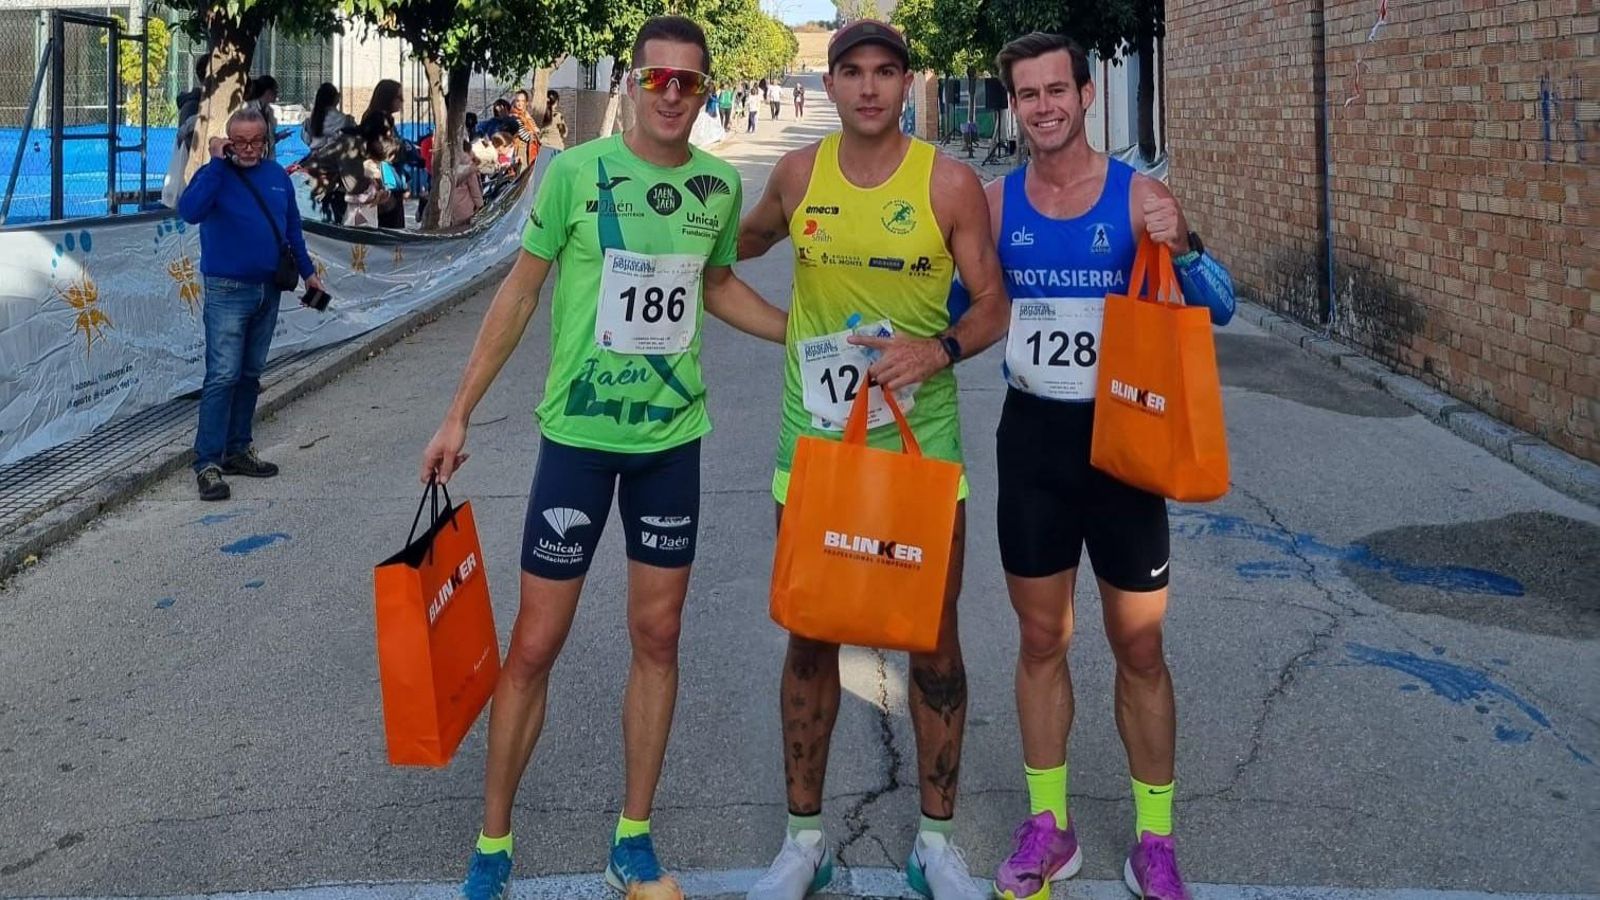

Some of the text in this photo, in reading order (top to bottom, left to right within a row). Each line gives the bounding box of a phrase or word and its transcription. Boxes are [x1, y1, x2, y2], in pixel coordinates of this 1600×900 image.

[1007, 269, 1124, 288] TROTASIERRA
[619, 286, 687, 323] 186
[1026, 330, 1097, 367] 128
[1110, 379, 1166, 412] BLINKER
[539, 537, 583, 555] Unicaja
[823, 530, 923, 562] BLINKER
[428, 552, 477, 625] BLINKER
